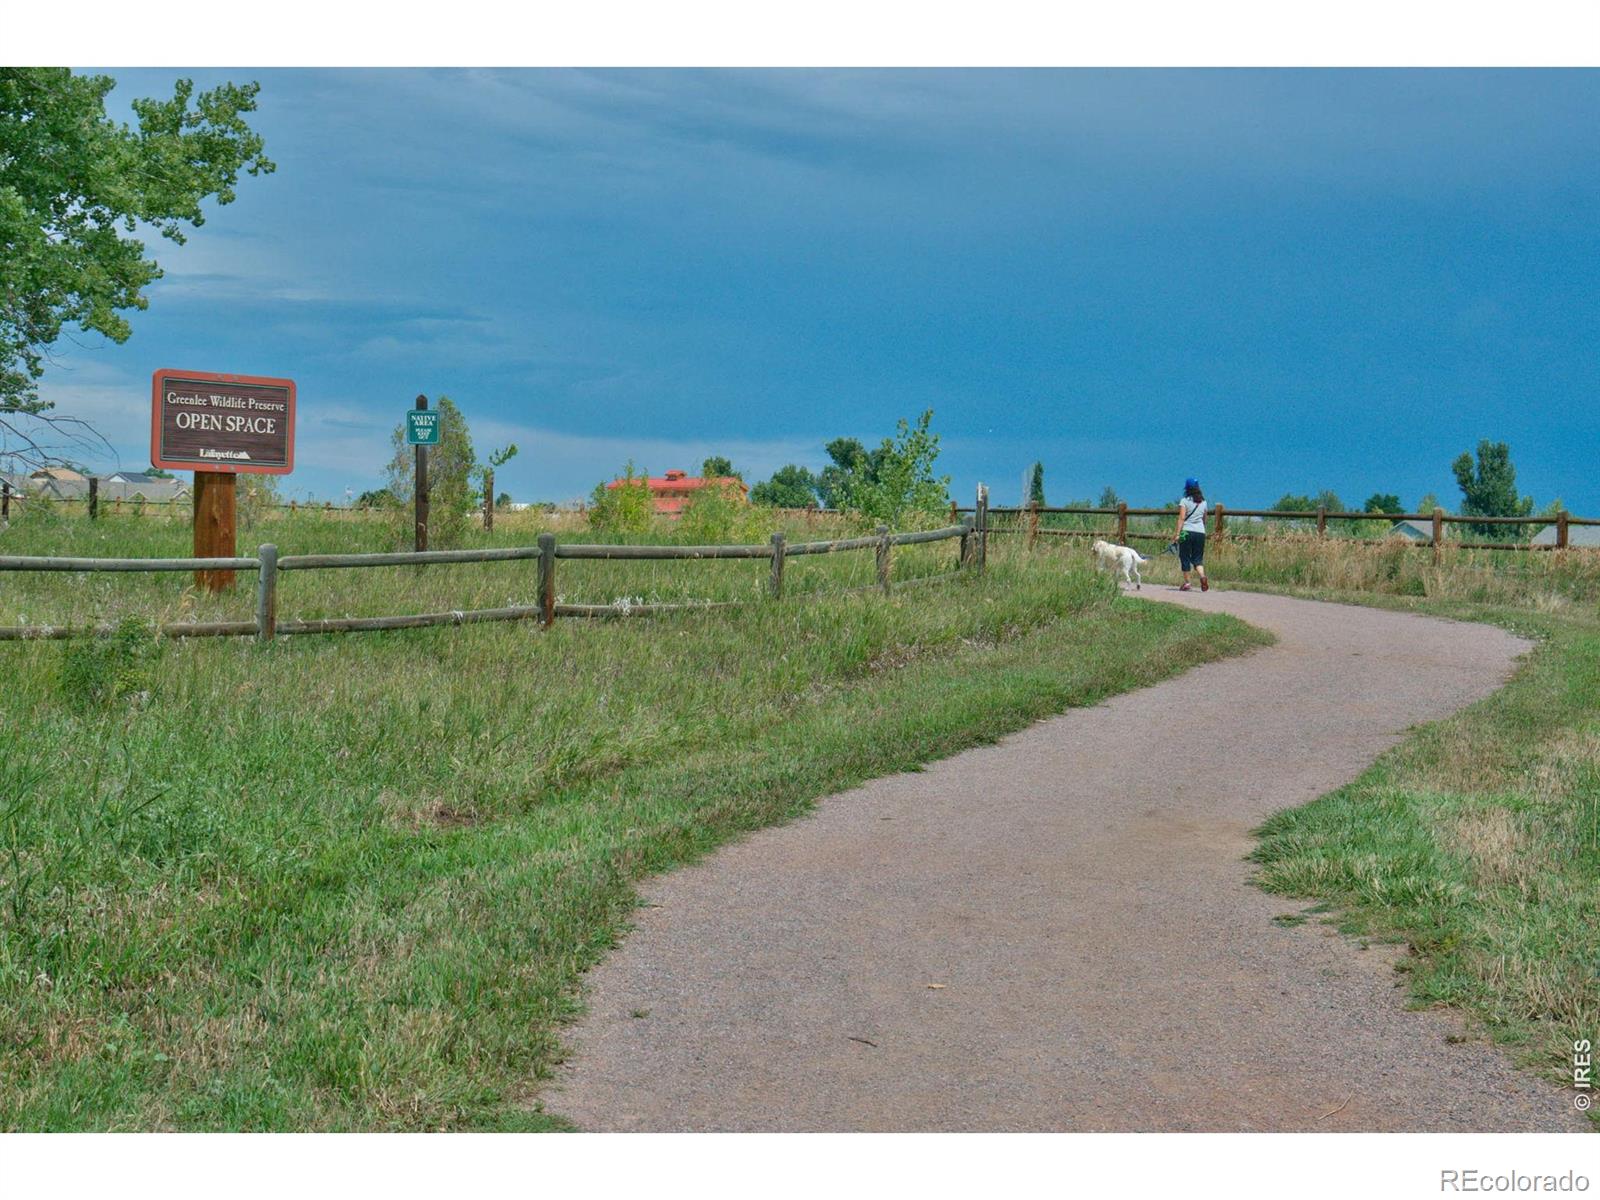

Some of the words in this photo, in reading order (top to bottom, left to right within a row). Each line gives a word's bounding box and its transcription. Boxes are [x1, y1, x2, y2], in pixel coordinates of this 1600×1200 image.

[167, 392, 208, 406] Greenlee
[210, 395, 246, 409] Wildlife
[248, 398, 285, 412] Preserve
[176, 412, 223, 431] OPEN
[225, 415, 276, 434] SPACE
